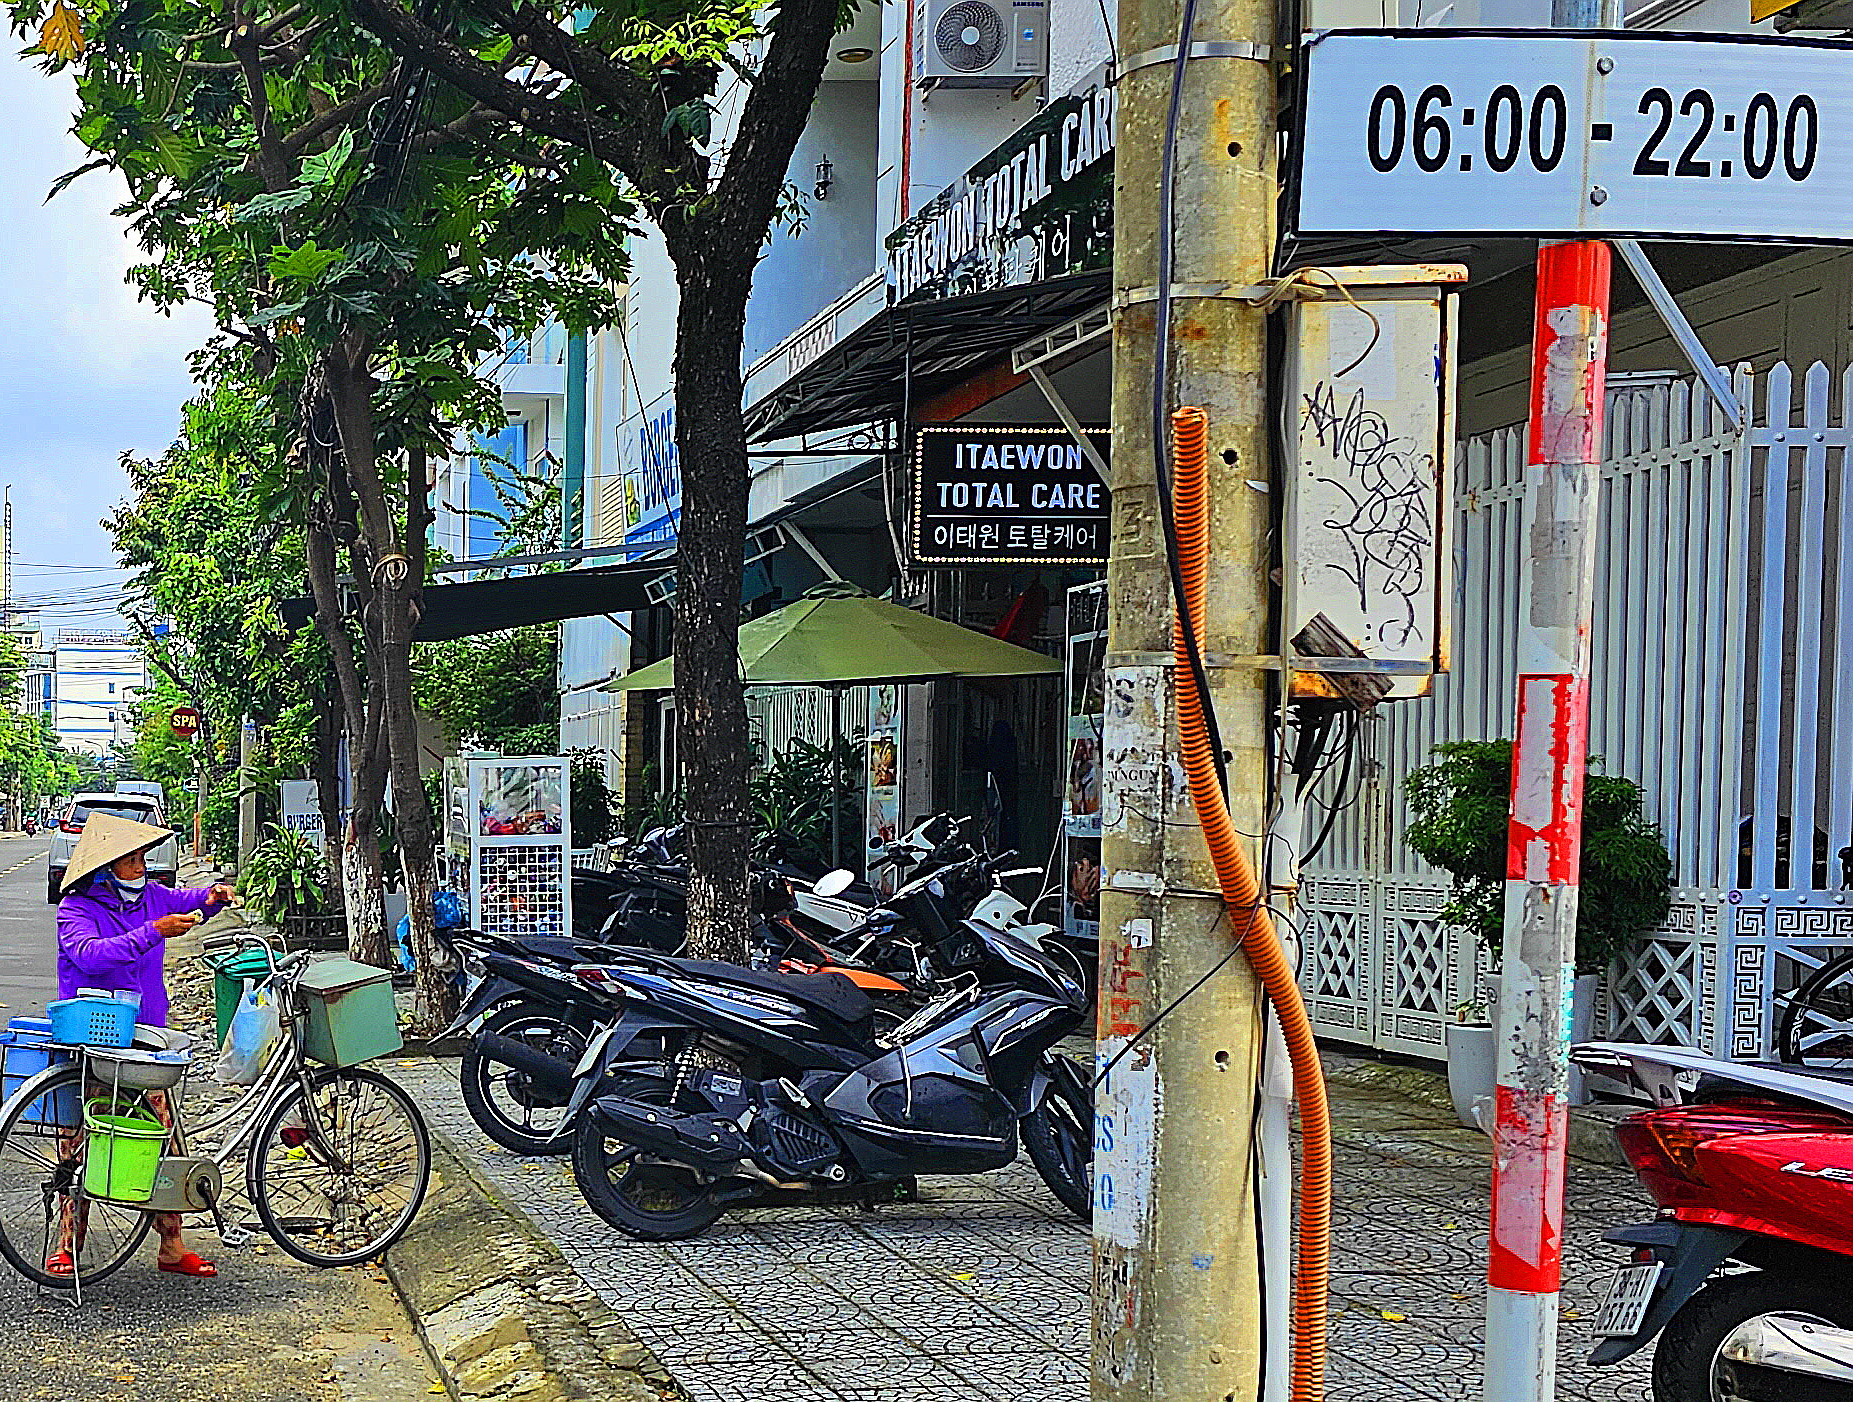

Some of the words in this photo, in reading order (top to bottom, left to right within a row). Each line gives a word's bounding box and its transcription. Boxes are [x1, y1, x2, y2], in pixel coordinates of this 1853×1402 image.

[1367, 84, 1567, 173] 06:00
[1591, 124, 1613, 140] -
[1634, 88, 1819, 181] 22:00
[984, 134, 1052, 237] TOTAL
[955, 443, 1083, 470] ITAEWON
[936, 482, 1020, 508] TOTAL
[1031, 483, 1101, 509] CARE
[934, 523, 1000, 550] 이태원
[1006, 523, 1097, 550] 토탈케어
[172, 714, 197, 728] SPA
[286, 813, 323, 831] BURGER
